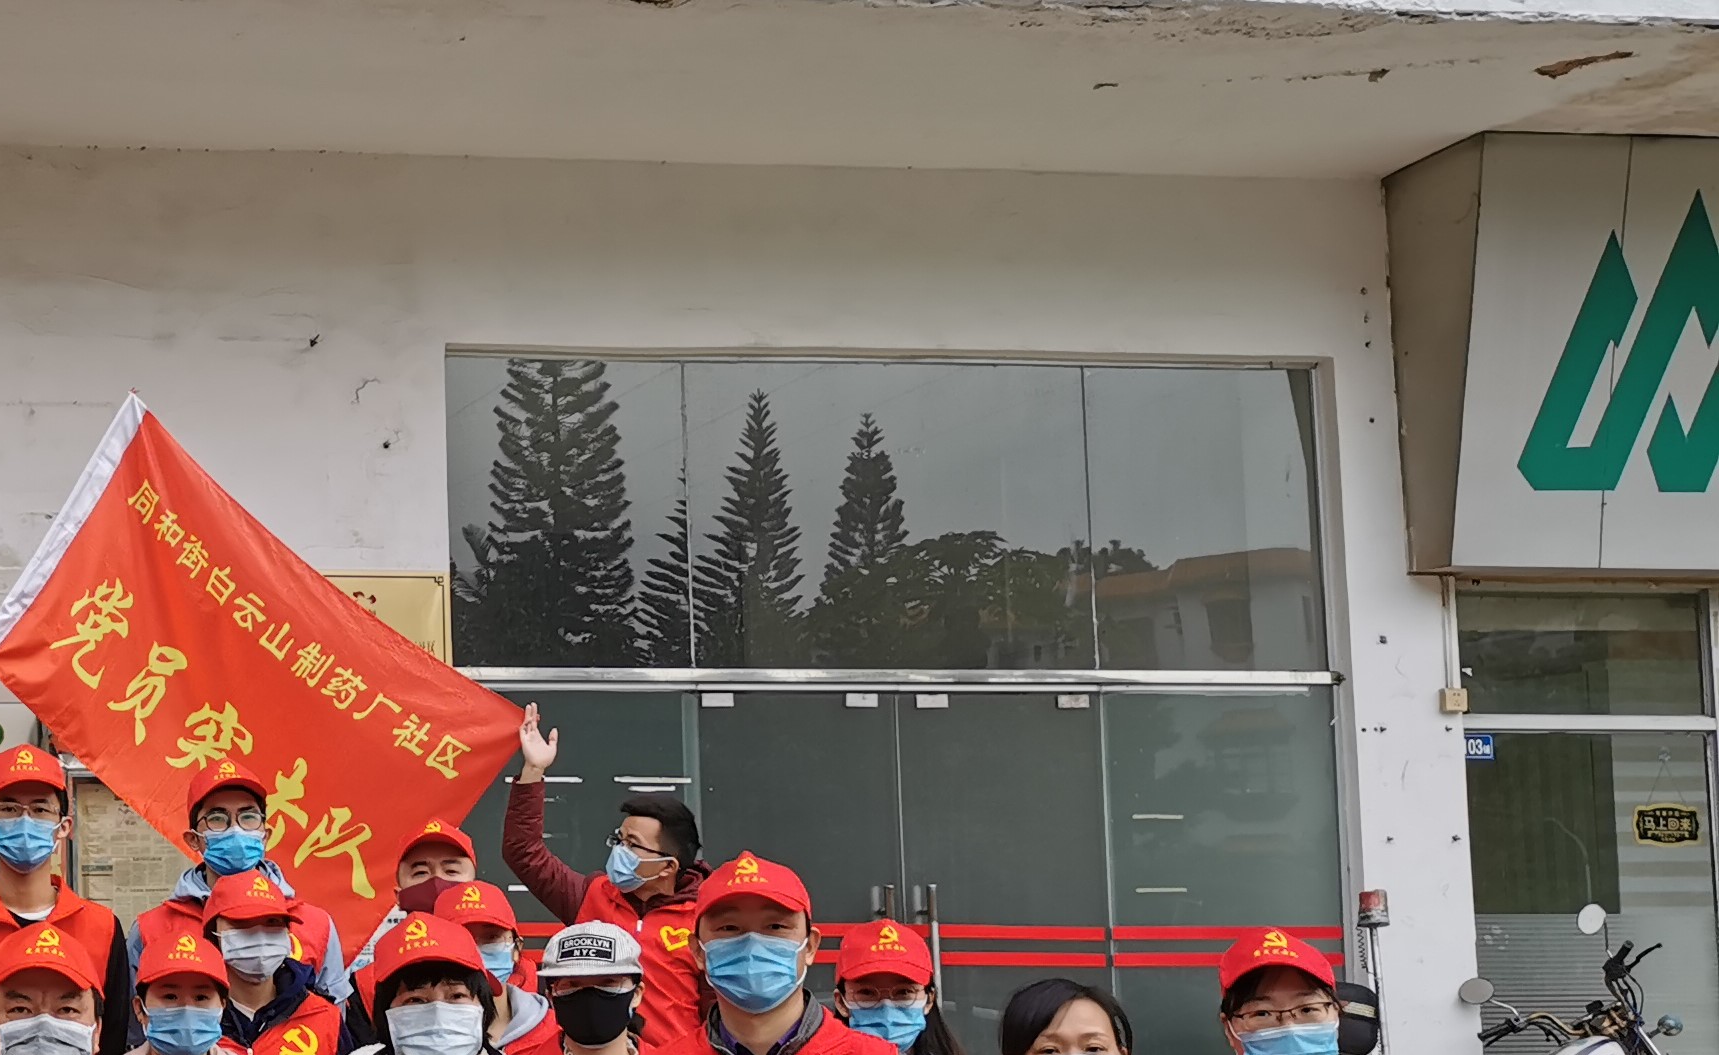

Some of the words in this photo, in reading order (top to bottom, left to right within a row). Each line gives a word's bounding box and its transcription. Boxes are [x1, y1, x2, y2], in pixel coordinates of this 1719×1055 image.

[127, 478, 472, 780] 同和街白云山制药厂社区
[563, 937, 610, 949] BROOKLYN
